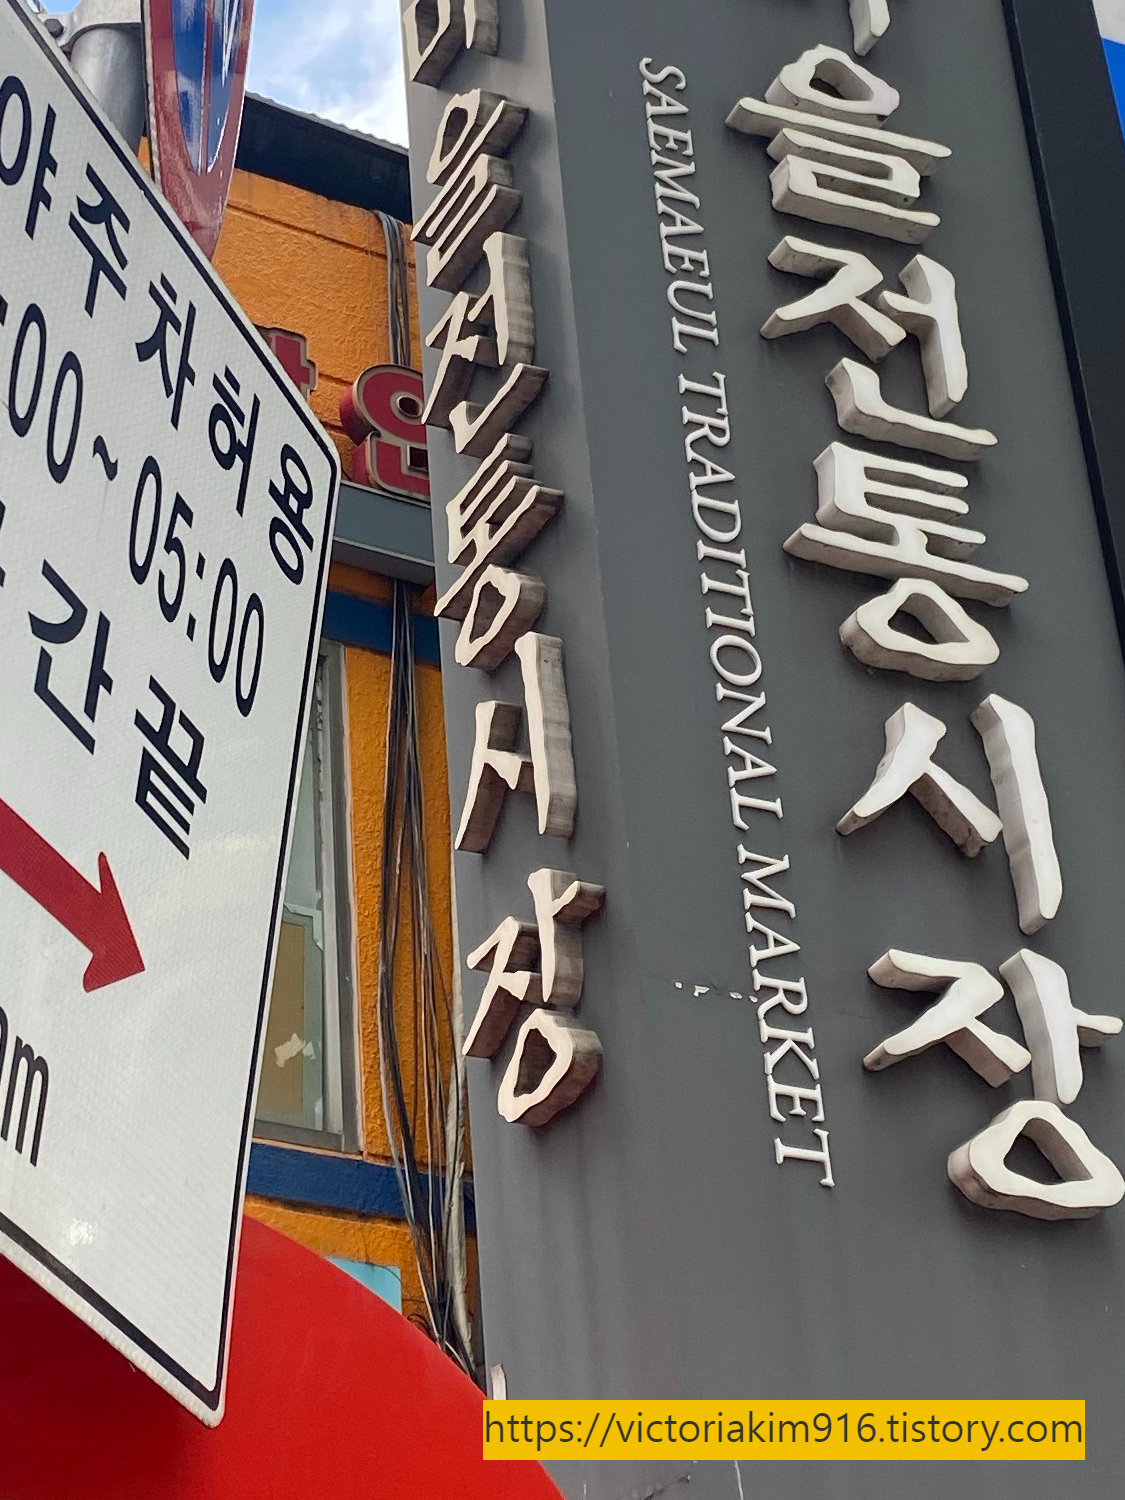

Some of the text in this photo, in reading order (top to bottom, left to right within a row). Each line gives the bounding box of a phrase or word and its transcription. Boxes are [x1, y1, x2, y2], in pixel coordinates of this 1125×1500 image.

[639, 56, 835, 1188] SAEMAEUL TRADITIONAL MARKET
